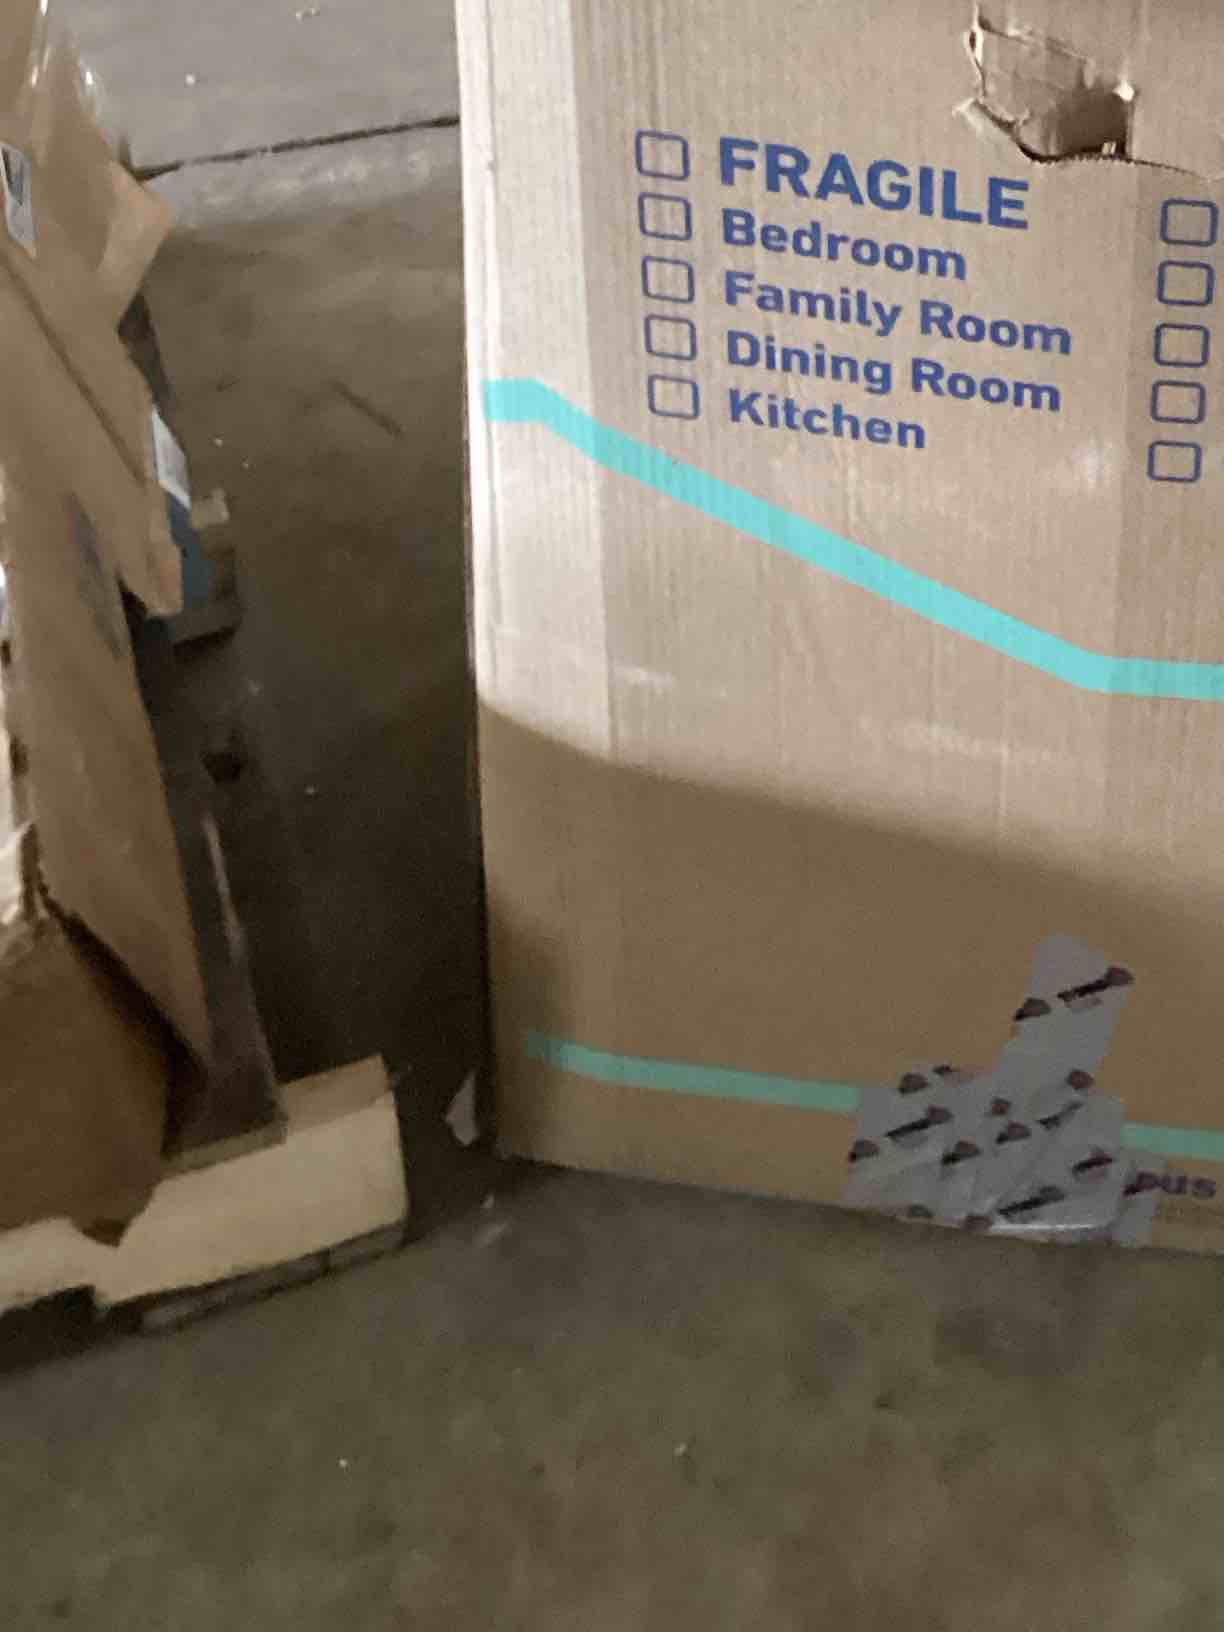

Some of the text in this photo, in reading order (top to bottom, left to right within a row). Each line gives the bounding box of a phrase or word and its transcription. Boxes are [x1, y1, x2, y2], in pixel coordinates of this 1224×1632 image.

[719, 136, 1029, 229] FRAGILE
[723, 208, 967, 280] Bedroom
[724, 270, 1072, 355] Family Room
[727, 330, 1061, 412] Dining Room
[728, 388, 926, 449] Kitchen
